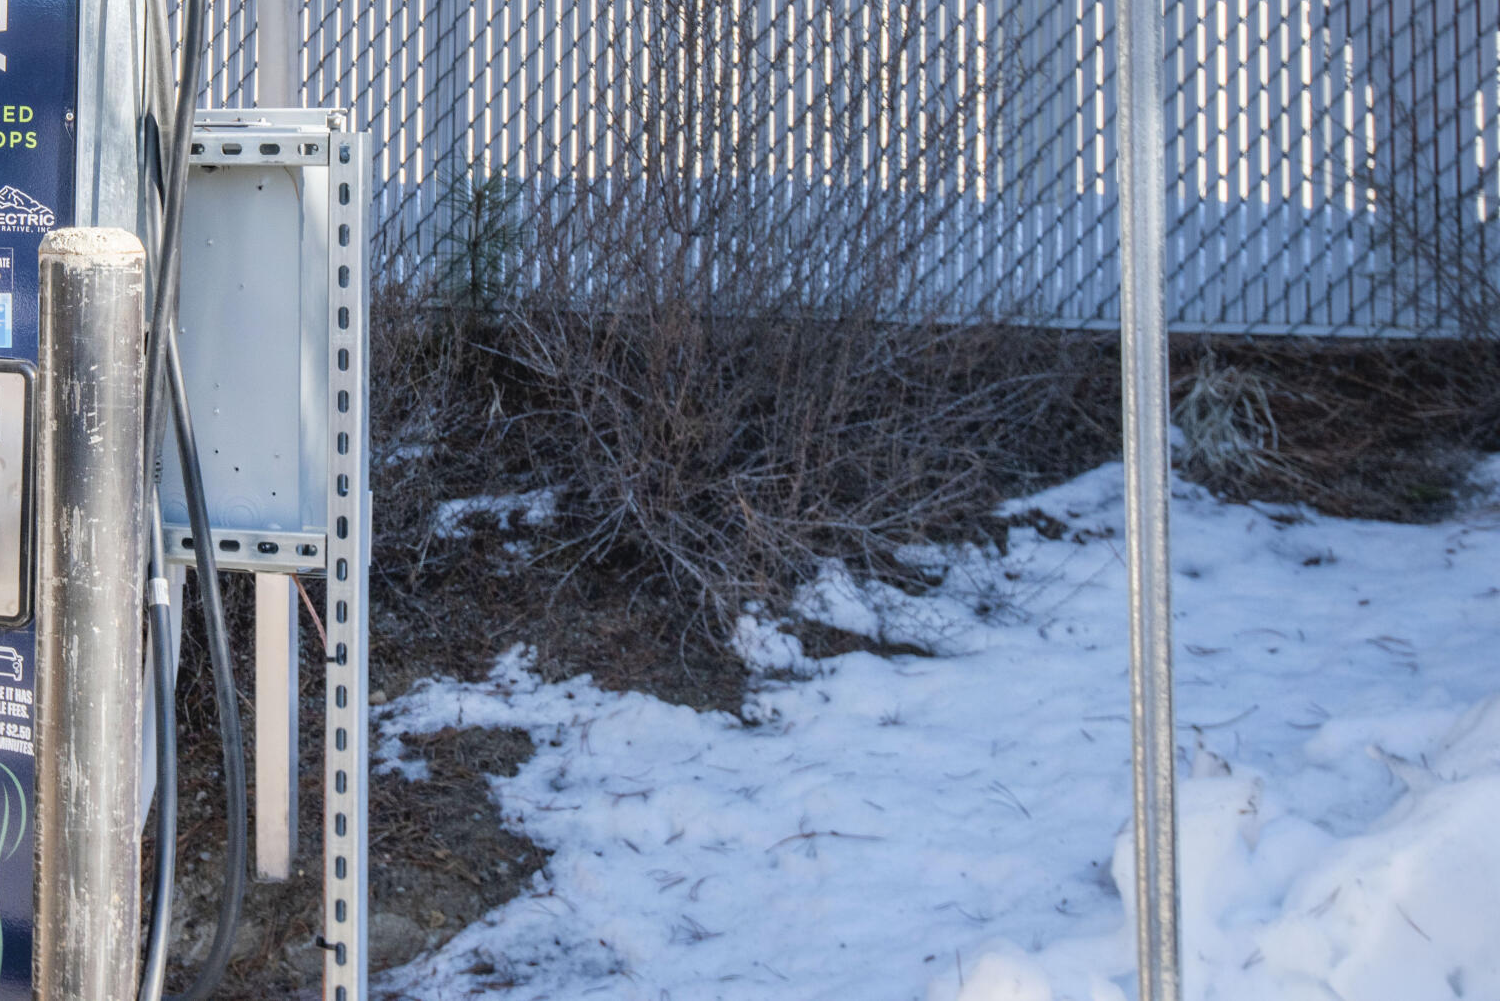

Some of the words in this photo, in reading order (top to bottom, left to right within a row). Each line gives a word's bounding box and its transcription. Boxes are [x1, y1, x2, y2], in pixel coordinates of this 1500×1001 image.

[5, 686, 14, 701] IT
[14, 687, 32, 704] HAS
[7, 701, 29, 719] FEES.
[6, 722, 31, 740] $2.50
